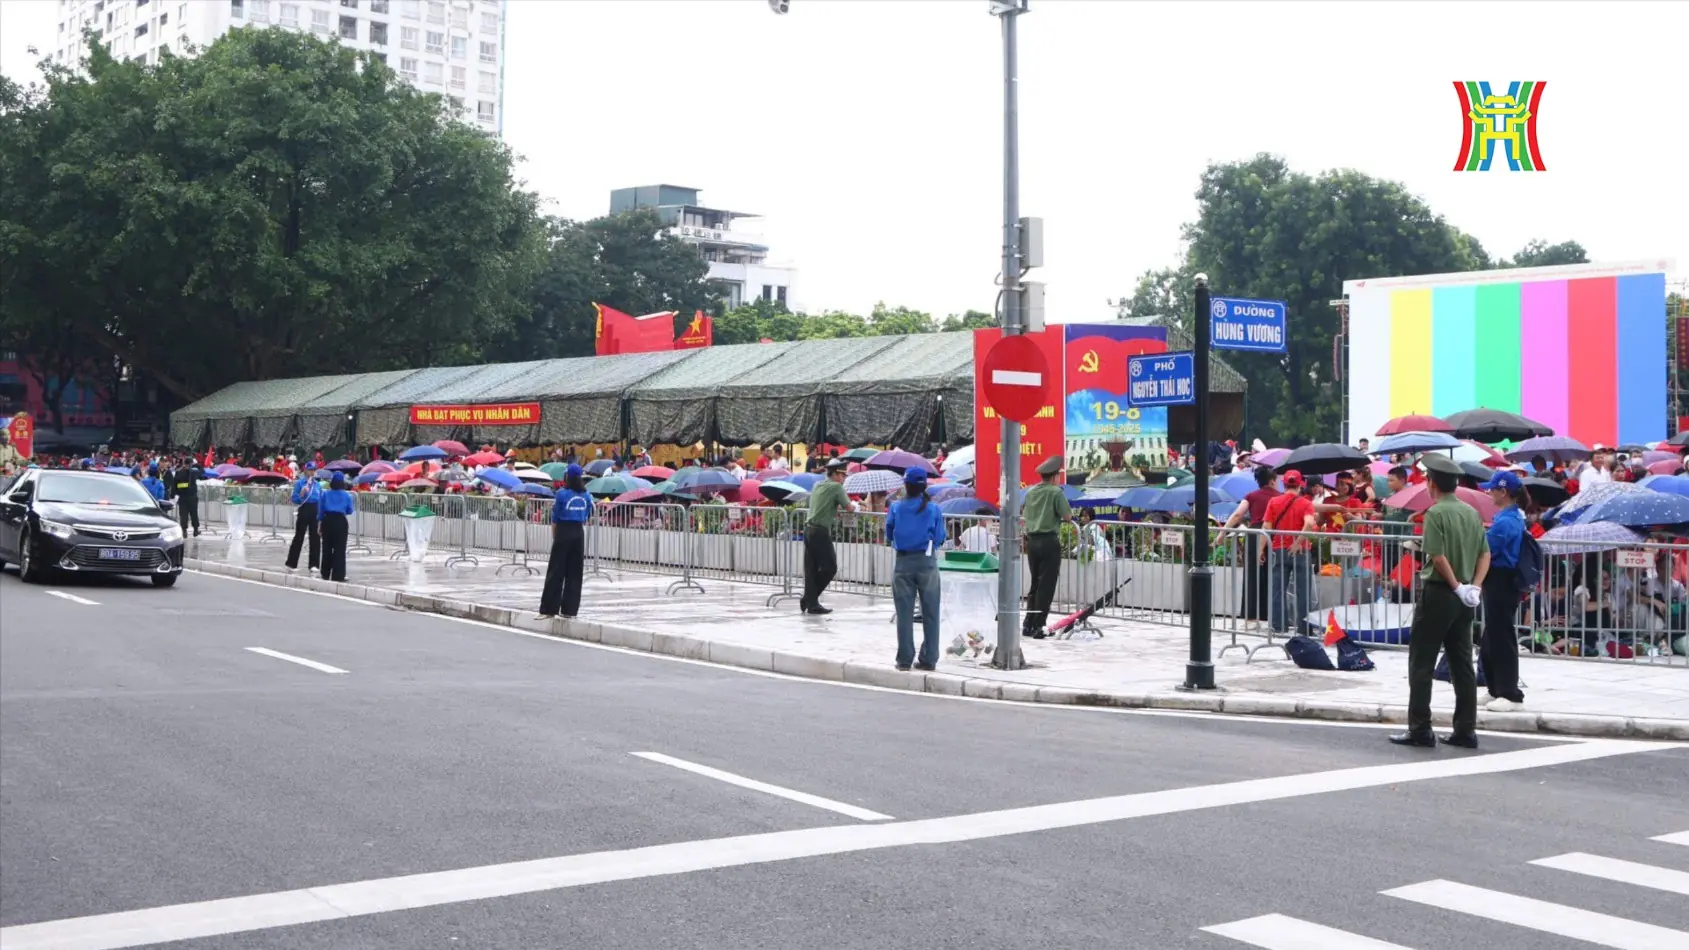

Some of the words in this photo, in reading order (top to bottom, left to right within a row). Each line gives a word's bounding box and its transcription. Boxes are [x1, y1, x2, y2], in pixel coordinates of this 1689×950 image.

[1215, 318, 1244, 340] HÙNG
[1247, 324, 1281, 343] VƯƠNG
[1154, 356, 1175, 371] PHỐ
[1132, 374, 1158, 399] NGUYỄN
[1160, 375, 1175, 397] THÁI
[1177, 377, 1190, 399] HỌC
[417, 408, 432, 420] NHÀ
[450, 409, 471, 422] PHỤC
[473, 409, 484, 422] VỤ
[485, 406, 509, 420] NHÂN
[511, 406, 531, 419] DÂN
